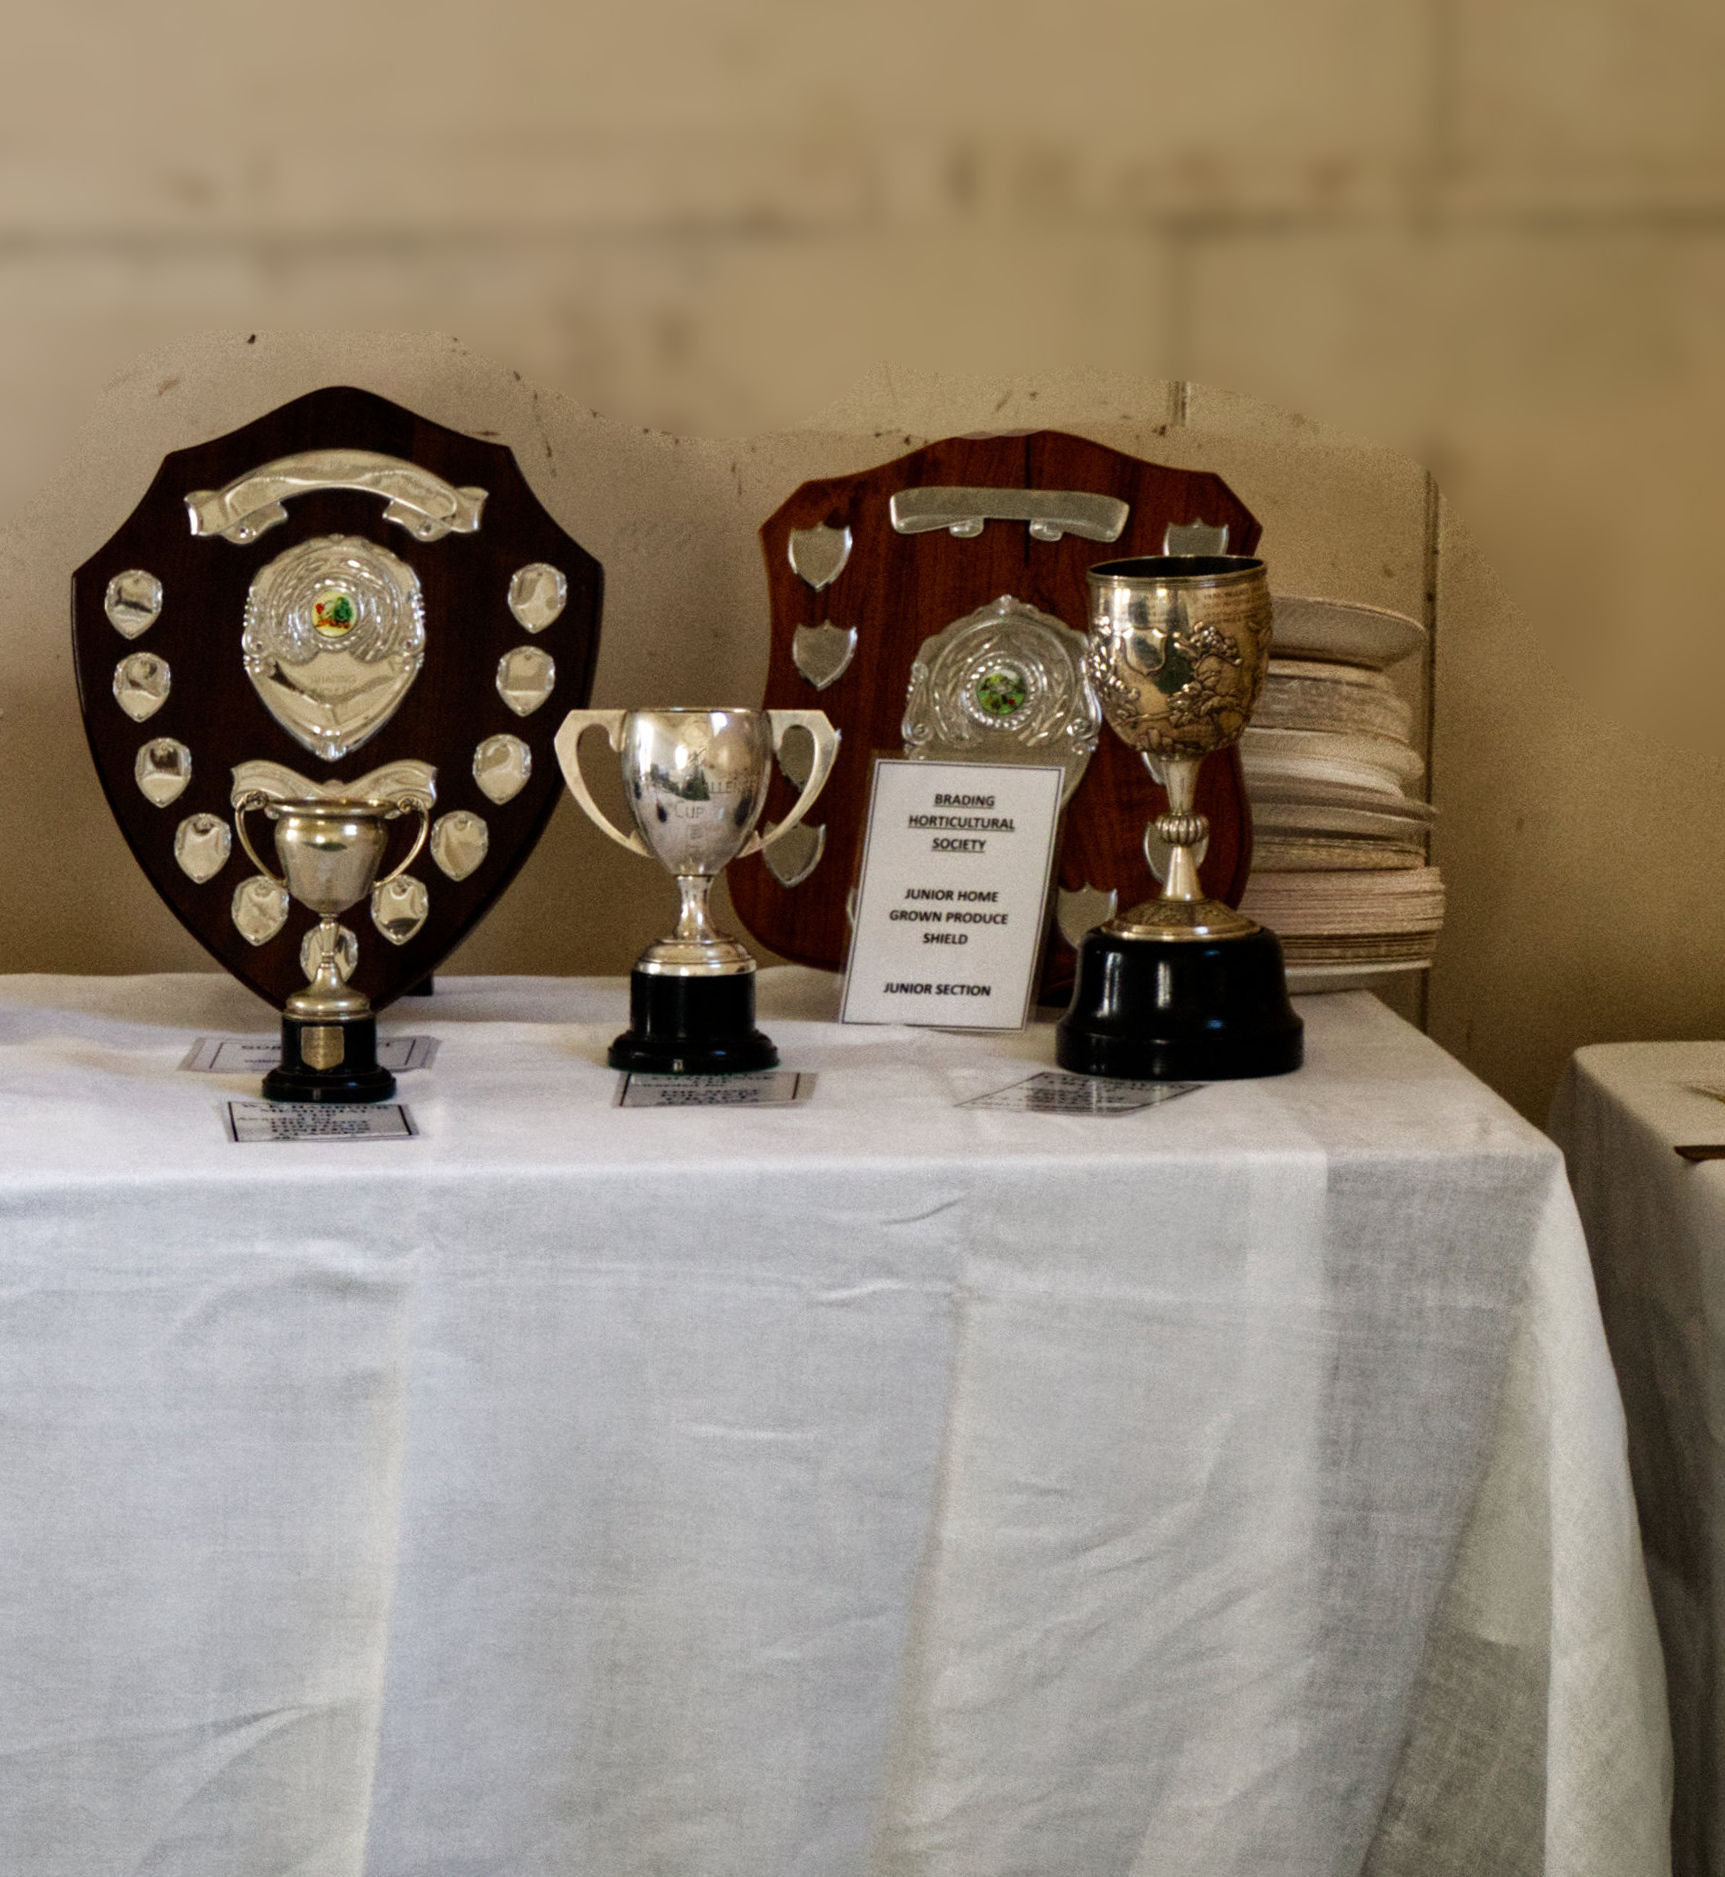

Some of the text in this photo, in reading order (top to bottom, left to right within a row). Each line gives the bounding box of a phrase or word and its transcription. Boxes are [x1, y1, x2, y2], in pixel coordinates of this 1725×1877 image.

[934, 793, 996, 809] BRADING
[908, 815, 1015, 832] HORTICULTURAL
[931, 837, 987, 852] SOCIETY
[904, 888, 999, 903] JUNIOR HOME
[889, 909, 1009, 925] GROWN PRODUCE
[922, 932, 968, 945] SHIELD
[883, 982, 992, 997] JUNIOR SECTION
